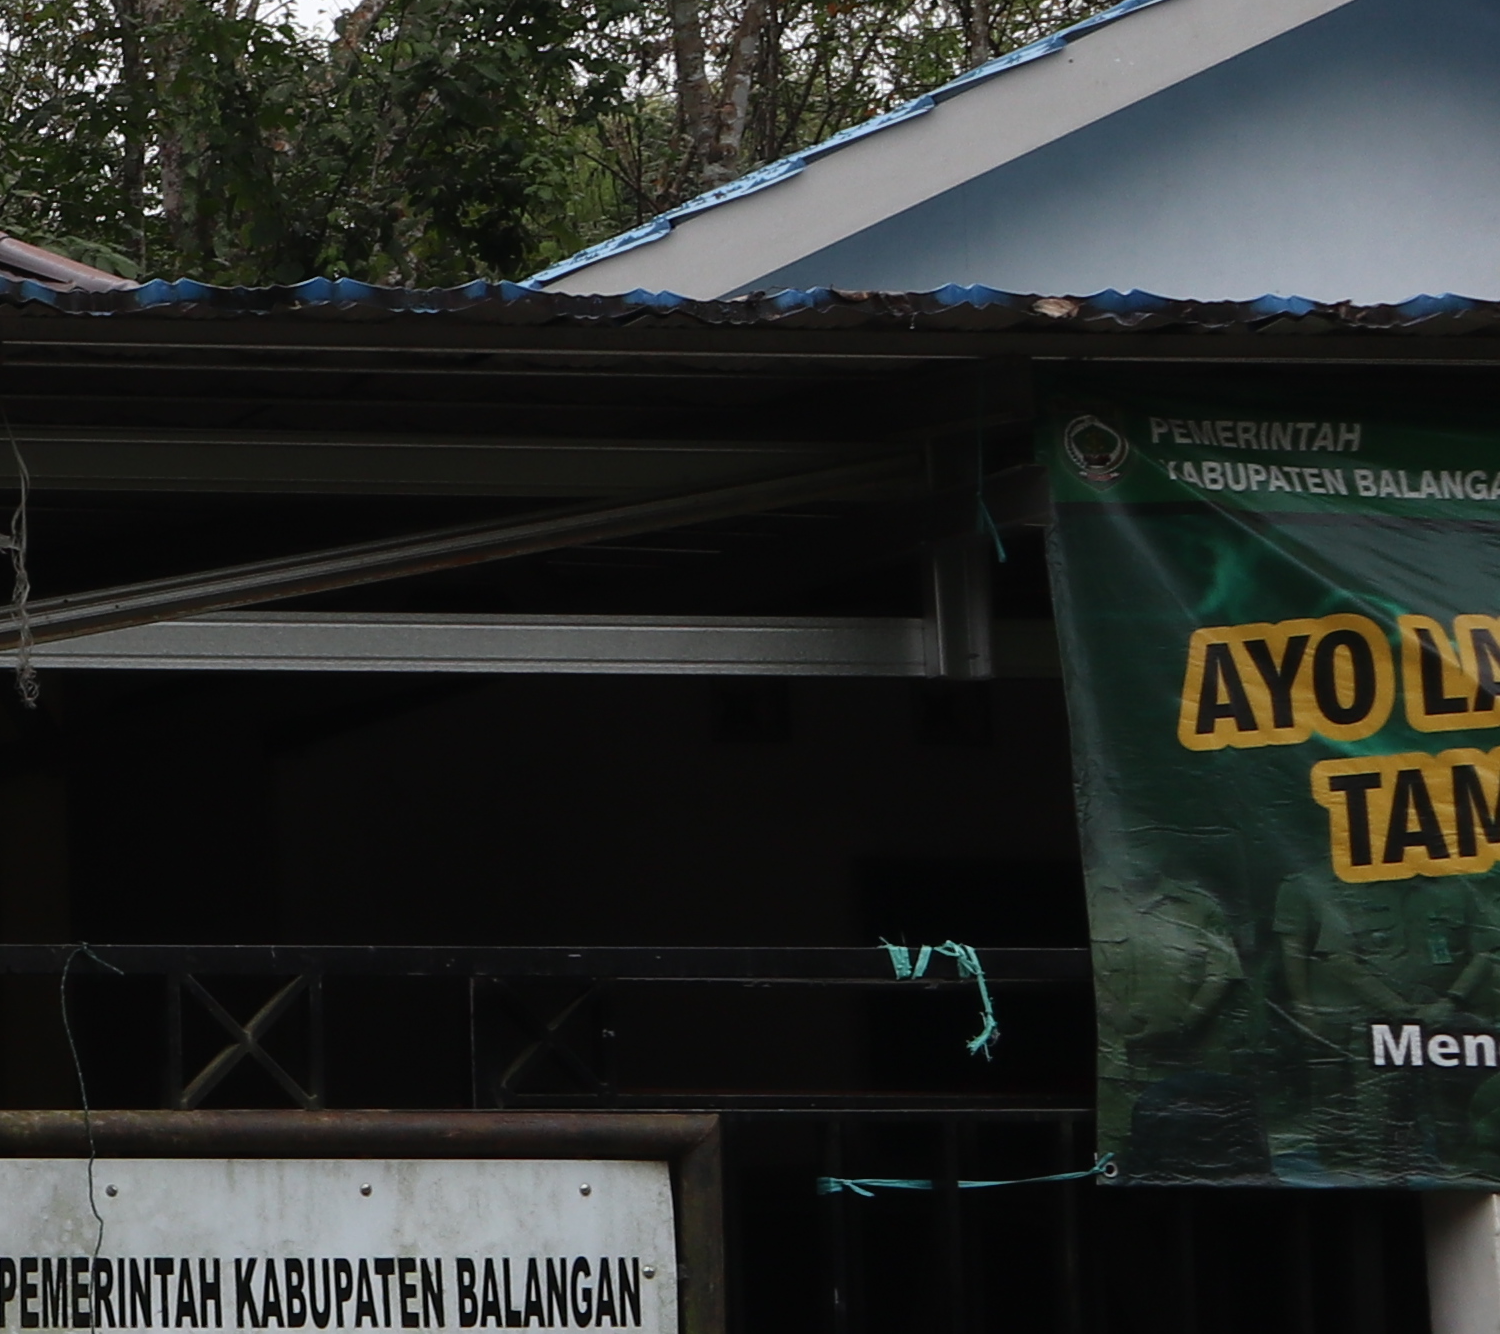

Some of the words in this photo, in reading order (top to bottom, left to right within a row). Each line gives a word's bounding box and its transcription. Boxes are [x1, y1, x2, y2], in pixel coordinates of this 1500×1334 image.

[1151, 418, 1361, 451] PEMERINTAH
[1195, 629, 1376, 735] AYO
[1371, 1024, 1500, 1067] Men
[234, 1257, 445, 1329] KABUPATEN
[456, 1256, 642, 1329] BALANGAN
